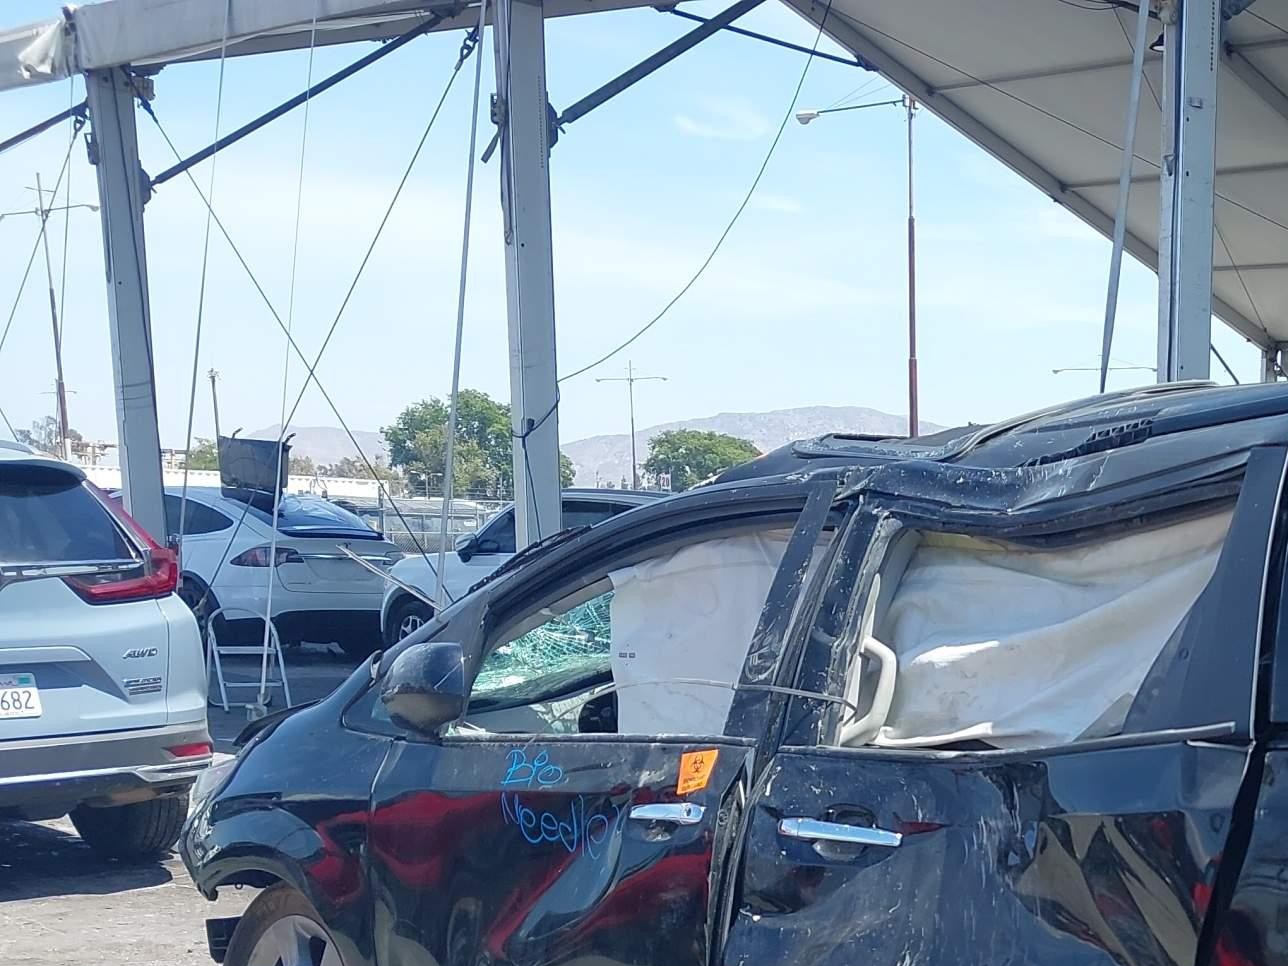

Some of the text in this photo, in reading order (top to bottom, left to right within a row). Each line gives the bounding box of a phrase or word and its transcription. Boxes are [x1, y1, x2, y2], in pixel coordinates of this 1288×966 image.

[122, 648, 158, 660] AWD
[0, 690, 35, 711] 682
[501, 748, 563, 788] Bio
